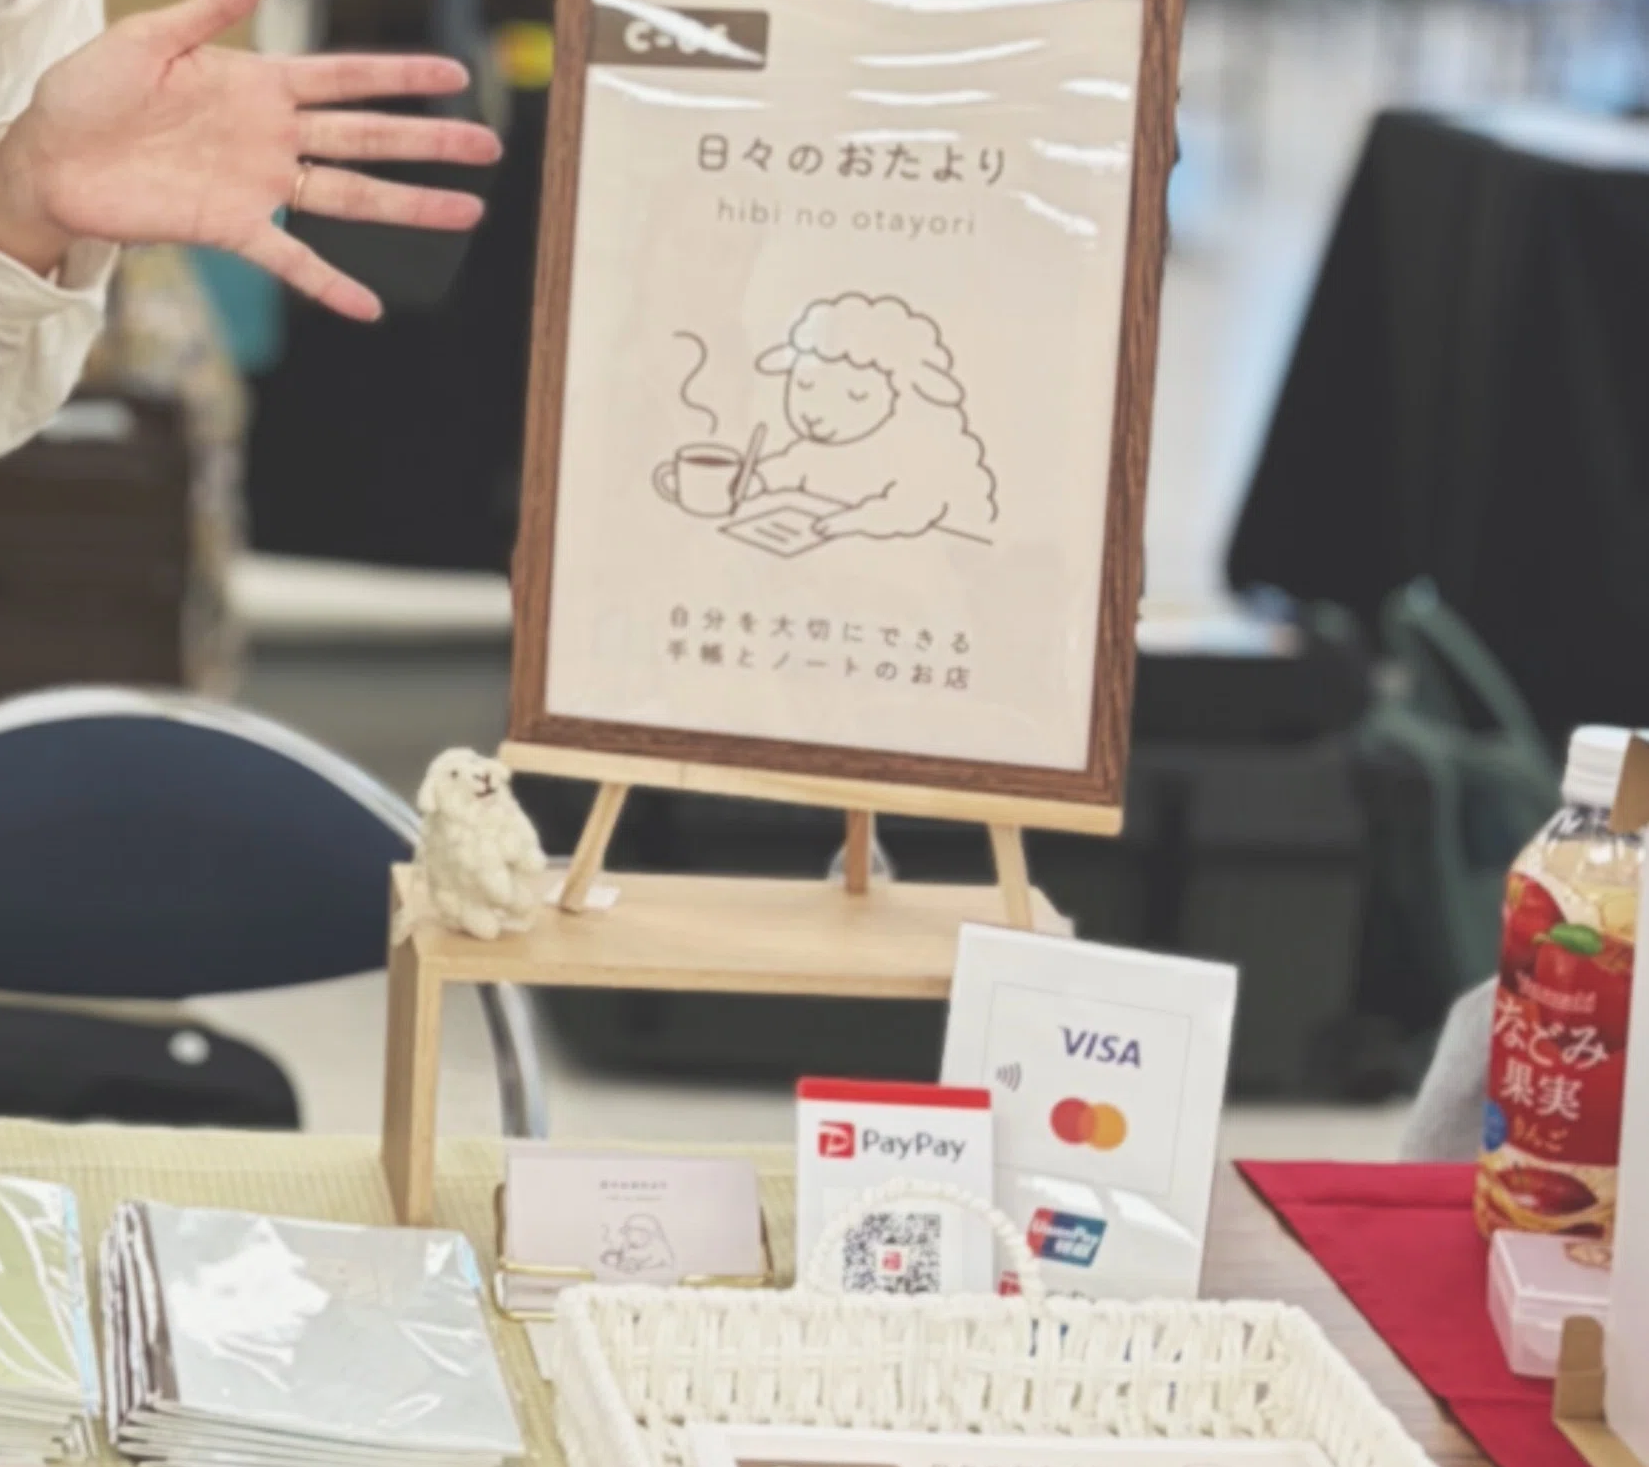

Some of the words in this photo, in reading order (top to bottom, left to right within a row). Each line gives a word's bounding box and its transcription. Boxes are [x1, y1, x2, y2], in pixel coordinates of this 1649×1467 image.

[698, 133, 1005, 186] 日々のおたより
[717, 197, 780, 224] hibi
[795, 208, 837, 228] no
[852, 209, 975, 240] otayori
[668, 605, 971, 655] 自分を大切にできる
[666, 638, 971, 690] 手帳とノートのお店
[1062, 1026, 1141, 1068] VISA
[1501, 1057, 1583, 1121] 果実
[862, 1129, 966, 1163] PayPay
